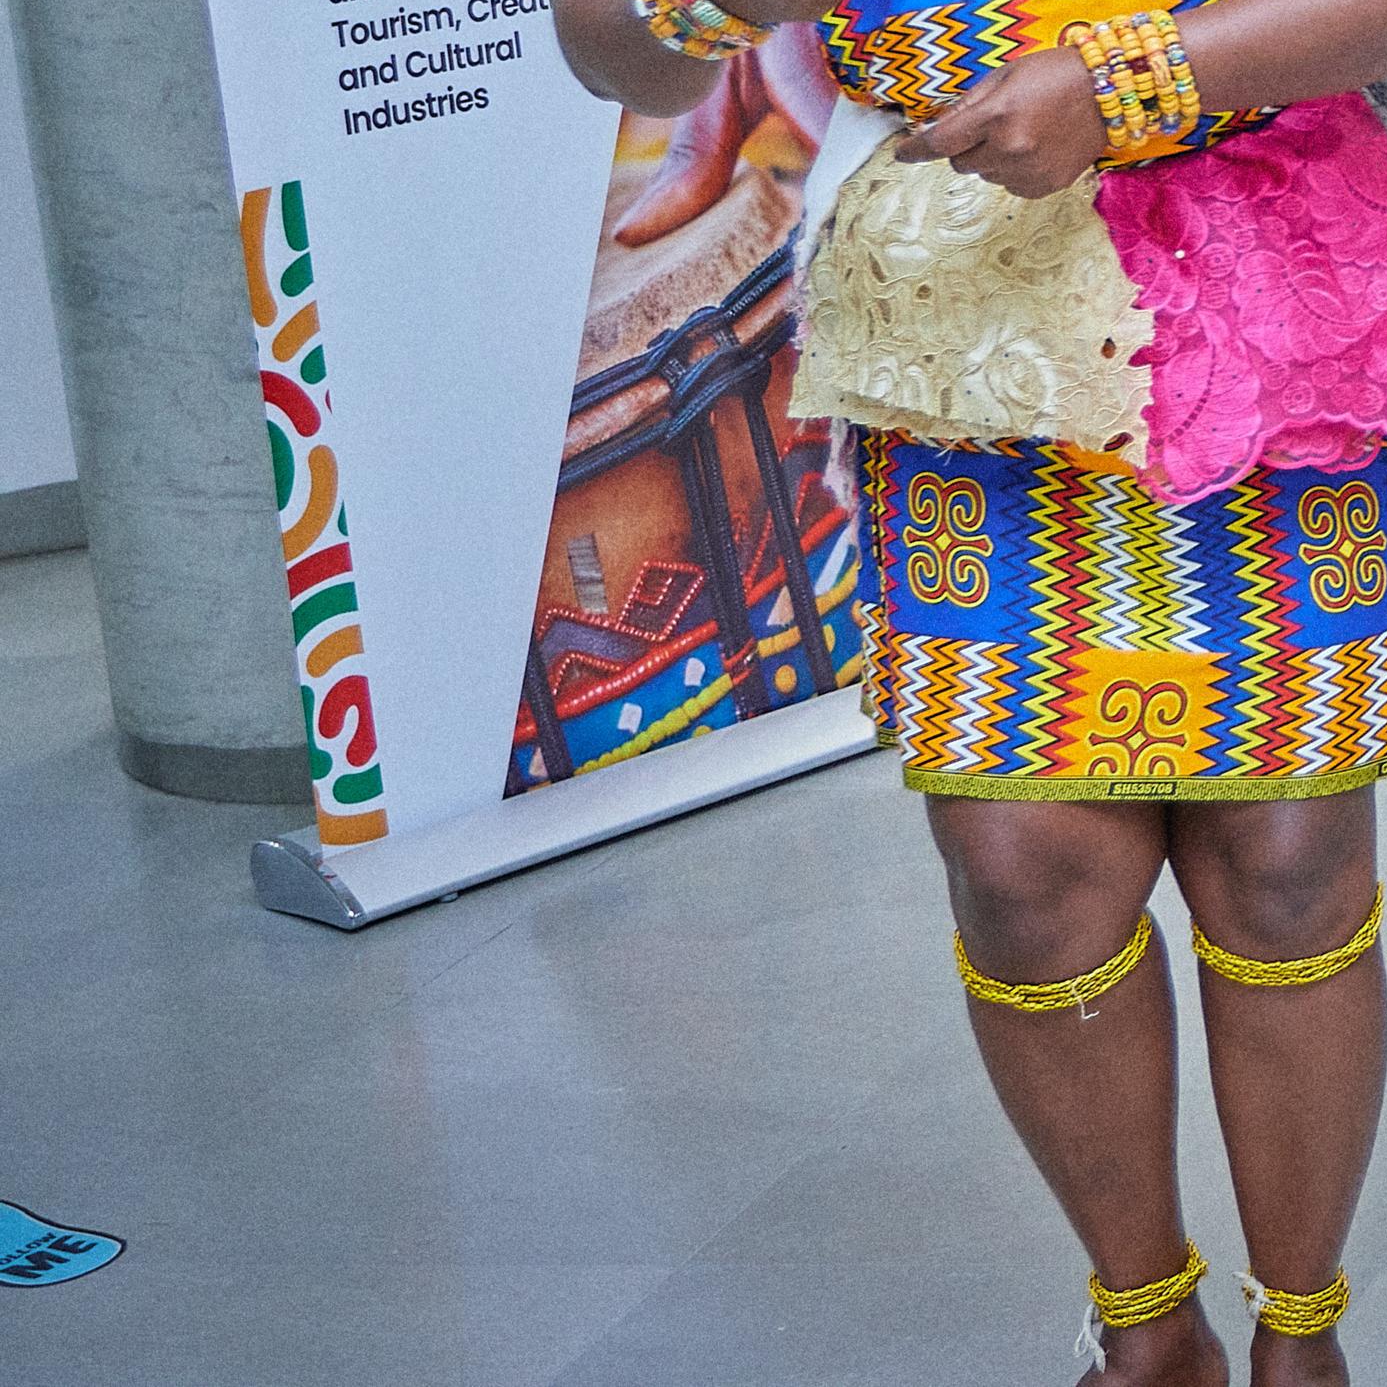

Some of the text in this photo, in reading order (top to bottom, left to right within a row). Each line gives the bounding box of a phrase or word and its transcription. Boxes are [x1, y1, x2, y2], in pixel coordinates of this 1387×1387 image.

[331, 6, 462, 48] Tourism,
[338, 31, 522, 91] and Cultural
[344, 86, 489, 135] Industries
[0, 1232, 56, 1265] OLLOW
[0, 1235, 98, 1279] ME
